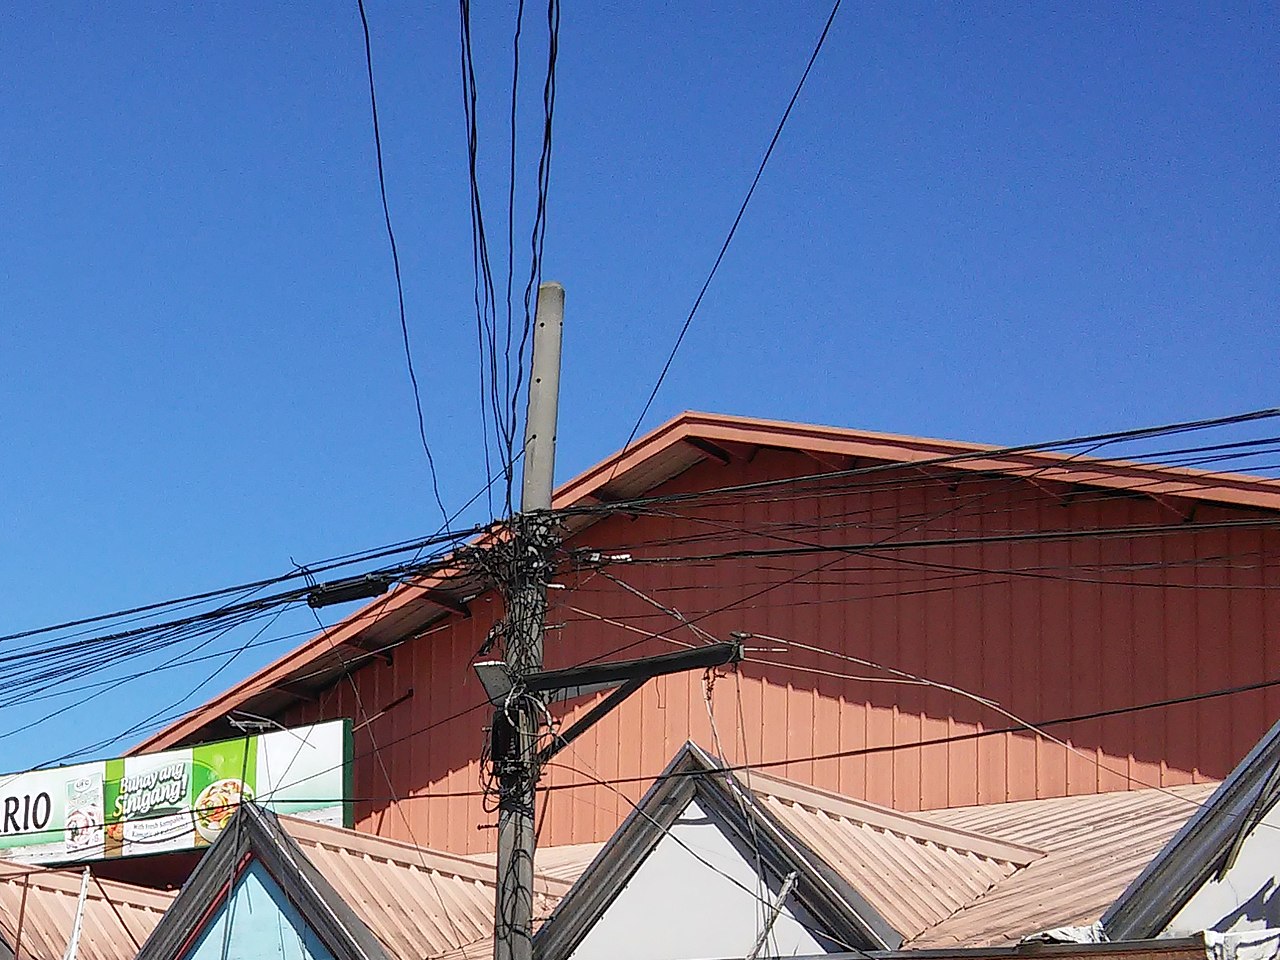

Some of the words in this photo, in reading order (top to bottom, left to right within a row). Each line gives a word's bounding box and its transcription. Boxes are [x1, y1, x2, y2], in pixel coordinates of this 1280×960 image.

[112, 774, 189, 818] Sinigang!
[120, 768, 158, 794] Buhay
[160, 762, 186, 784] ang
